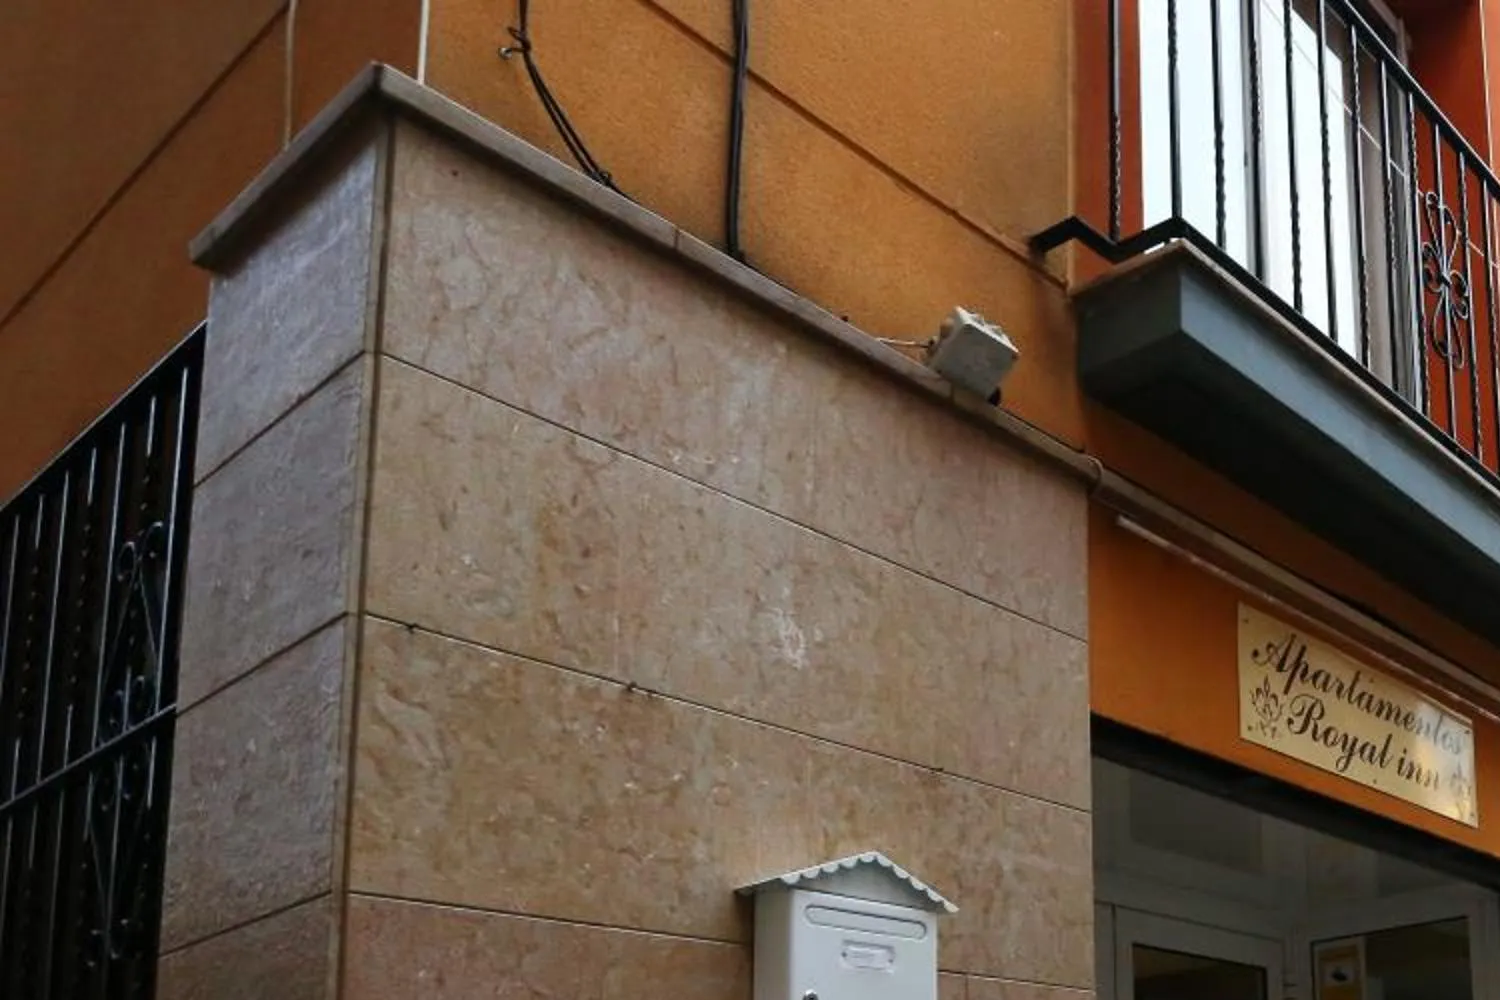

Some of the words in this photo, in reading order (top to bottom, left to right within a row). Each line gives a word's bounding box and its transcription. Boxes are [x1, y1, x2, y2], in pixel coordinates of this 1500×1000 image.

[1252, 633, 1462, 755] Apartamentos
[1287, 693, 1394, 773] Royal
[1397, 748, 1440, 791] inn
